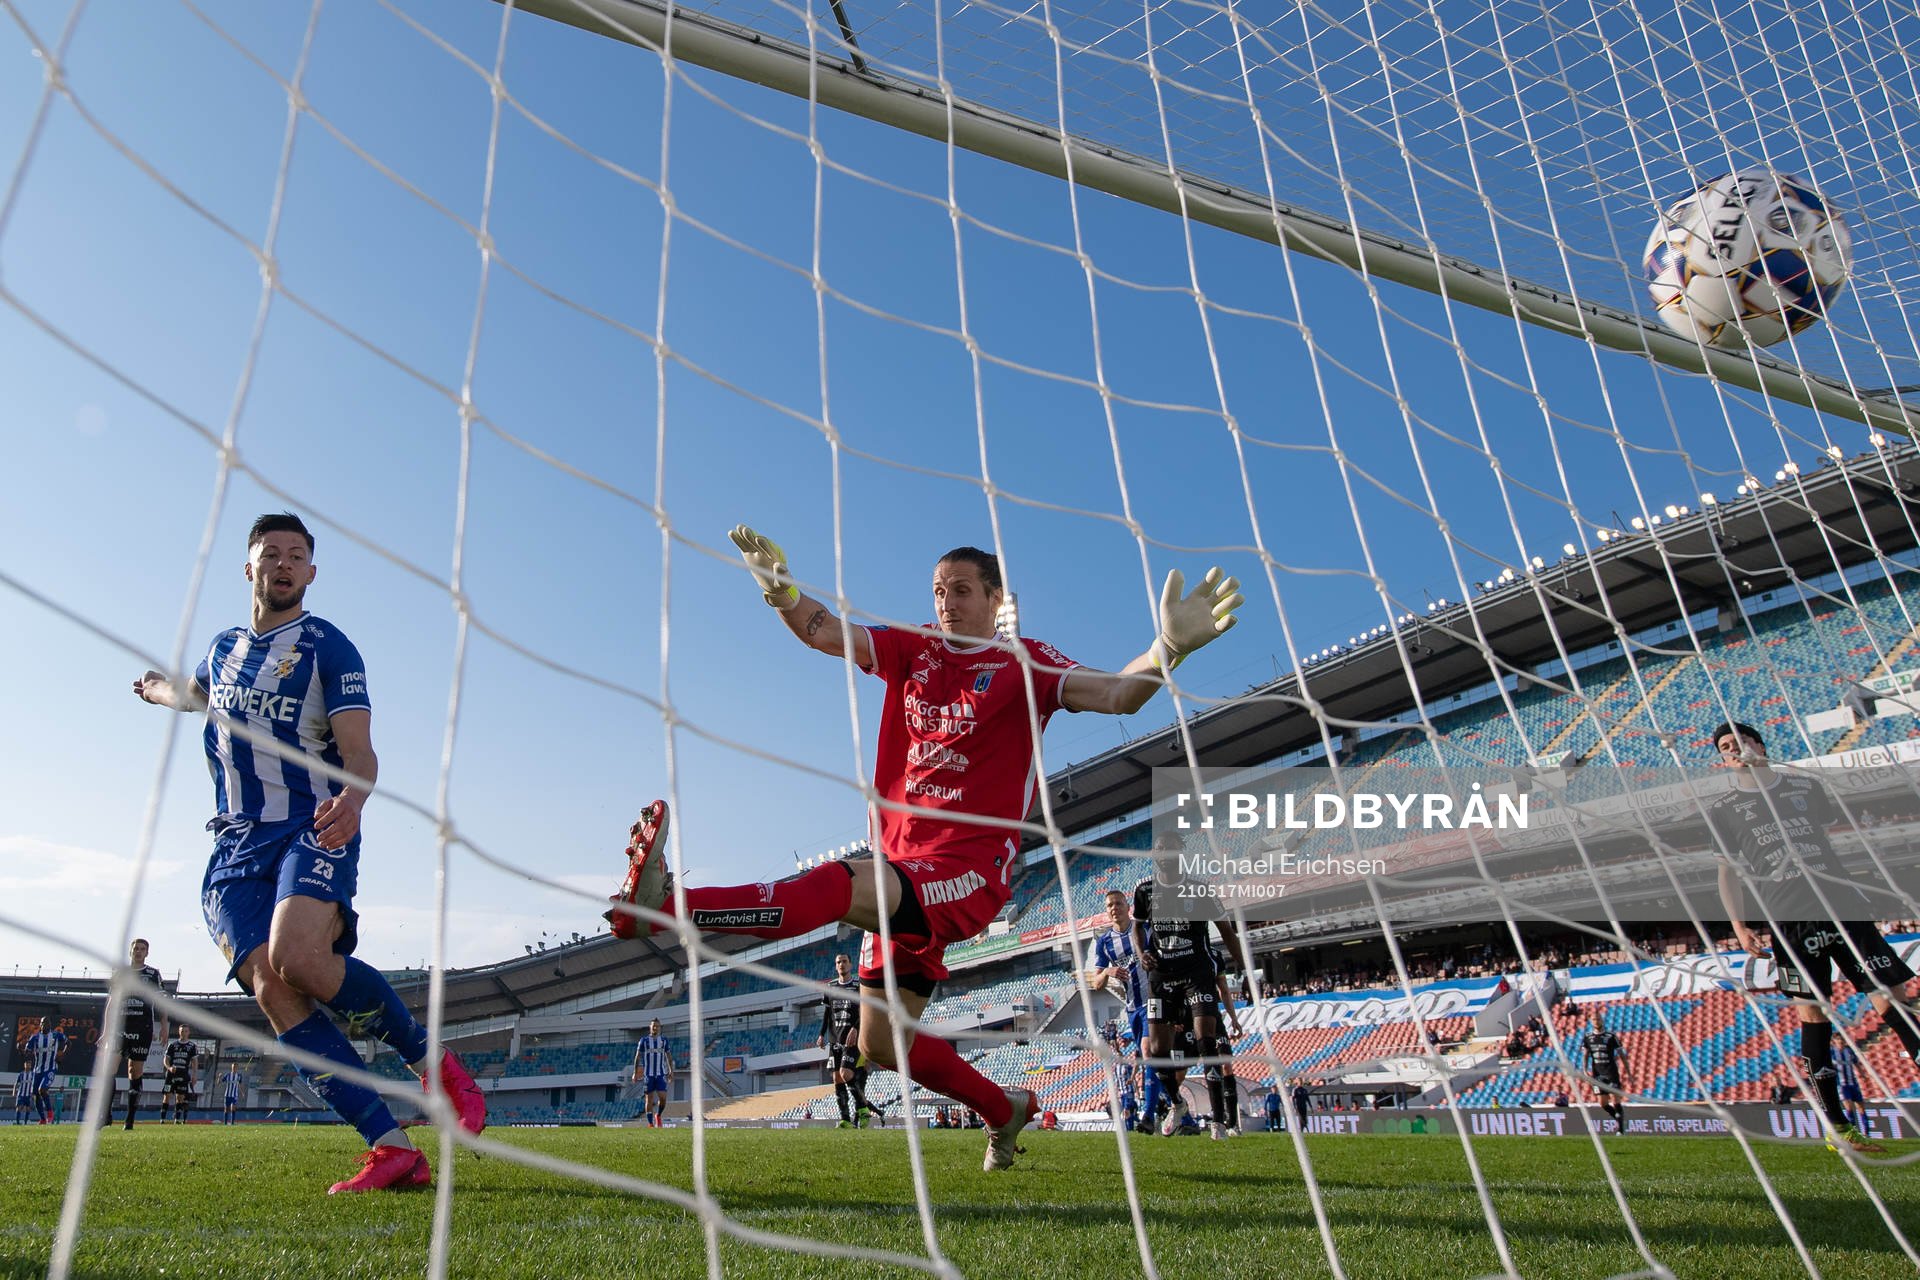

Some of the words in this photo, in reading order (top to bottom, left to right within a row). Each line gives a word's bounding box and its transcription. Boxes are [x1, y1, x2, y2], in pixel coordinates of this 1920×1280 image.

[905, 695, 939, 717] BYGG
[905, 711, 977, 735] CONSTRUCT
[1840, 745, 1900, 769] Ullevi
[905, 780, 962, 800] BILFORUM
[1752, 822, 1779, 837] BYGG
[312, 858, 335, 880] 23
[298, 876, 328, 888] CRAFT
[698, 912, 757, 925] Lundqvist
[1471, 1112, 1567, 1136] UNIBET
[1653, 1115, 1676, 1132] FÖR
